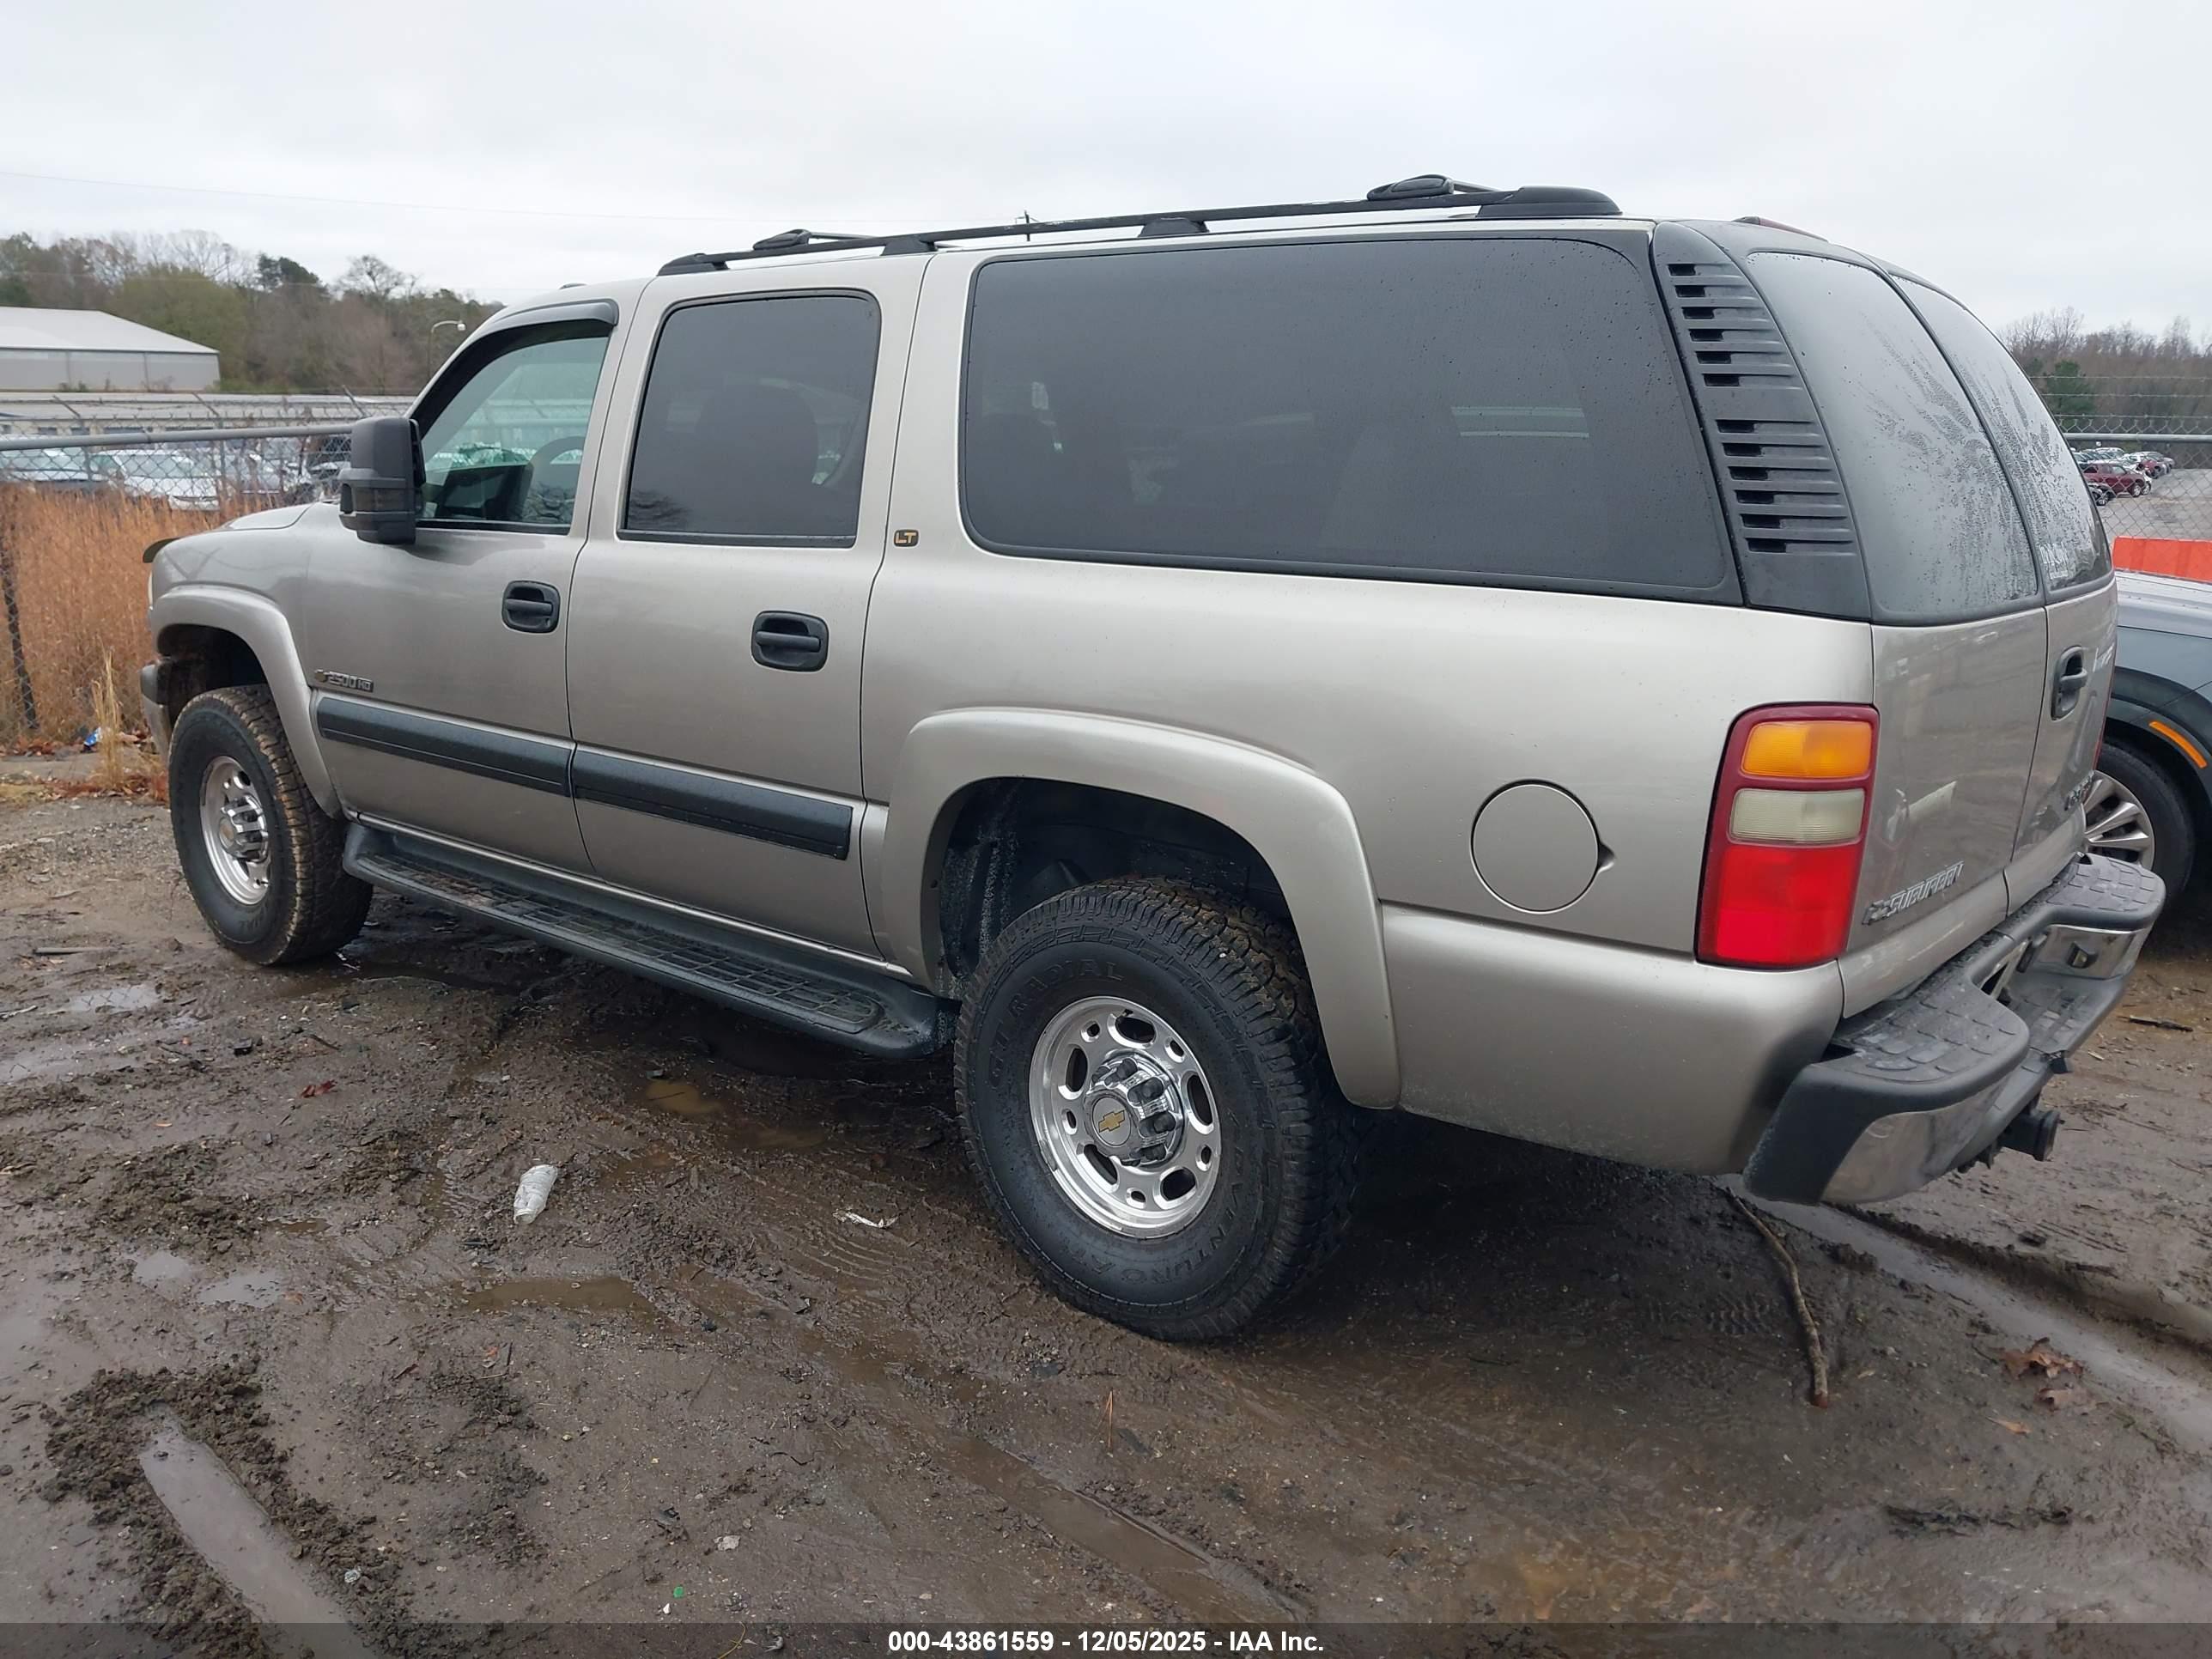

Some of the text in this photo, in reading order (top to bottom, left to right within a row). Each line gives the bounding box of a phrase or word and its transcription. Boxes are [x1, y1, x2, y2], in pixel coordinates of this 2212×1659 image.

[895, 532, 917, 544] LT
[328, 671, 358, 689] 2500
[1007, 957, 1126, 1018] RADIAL
